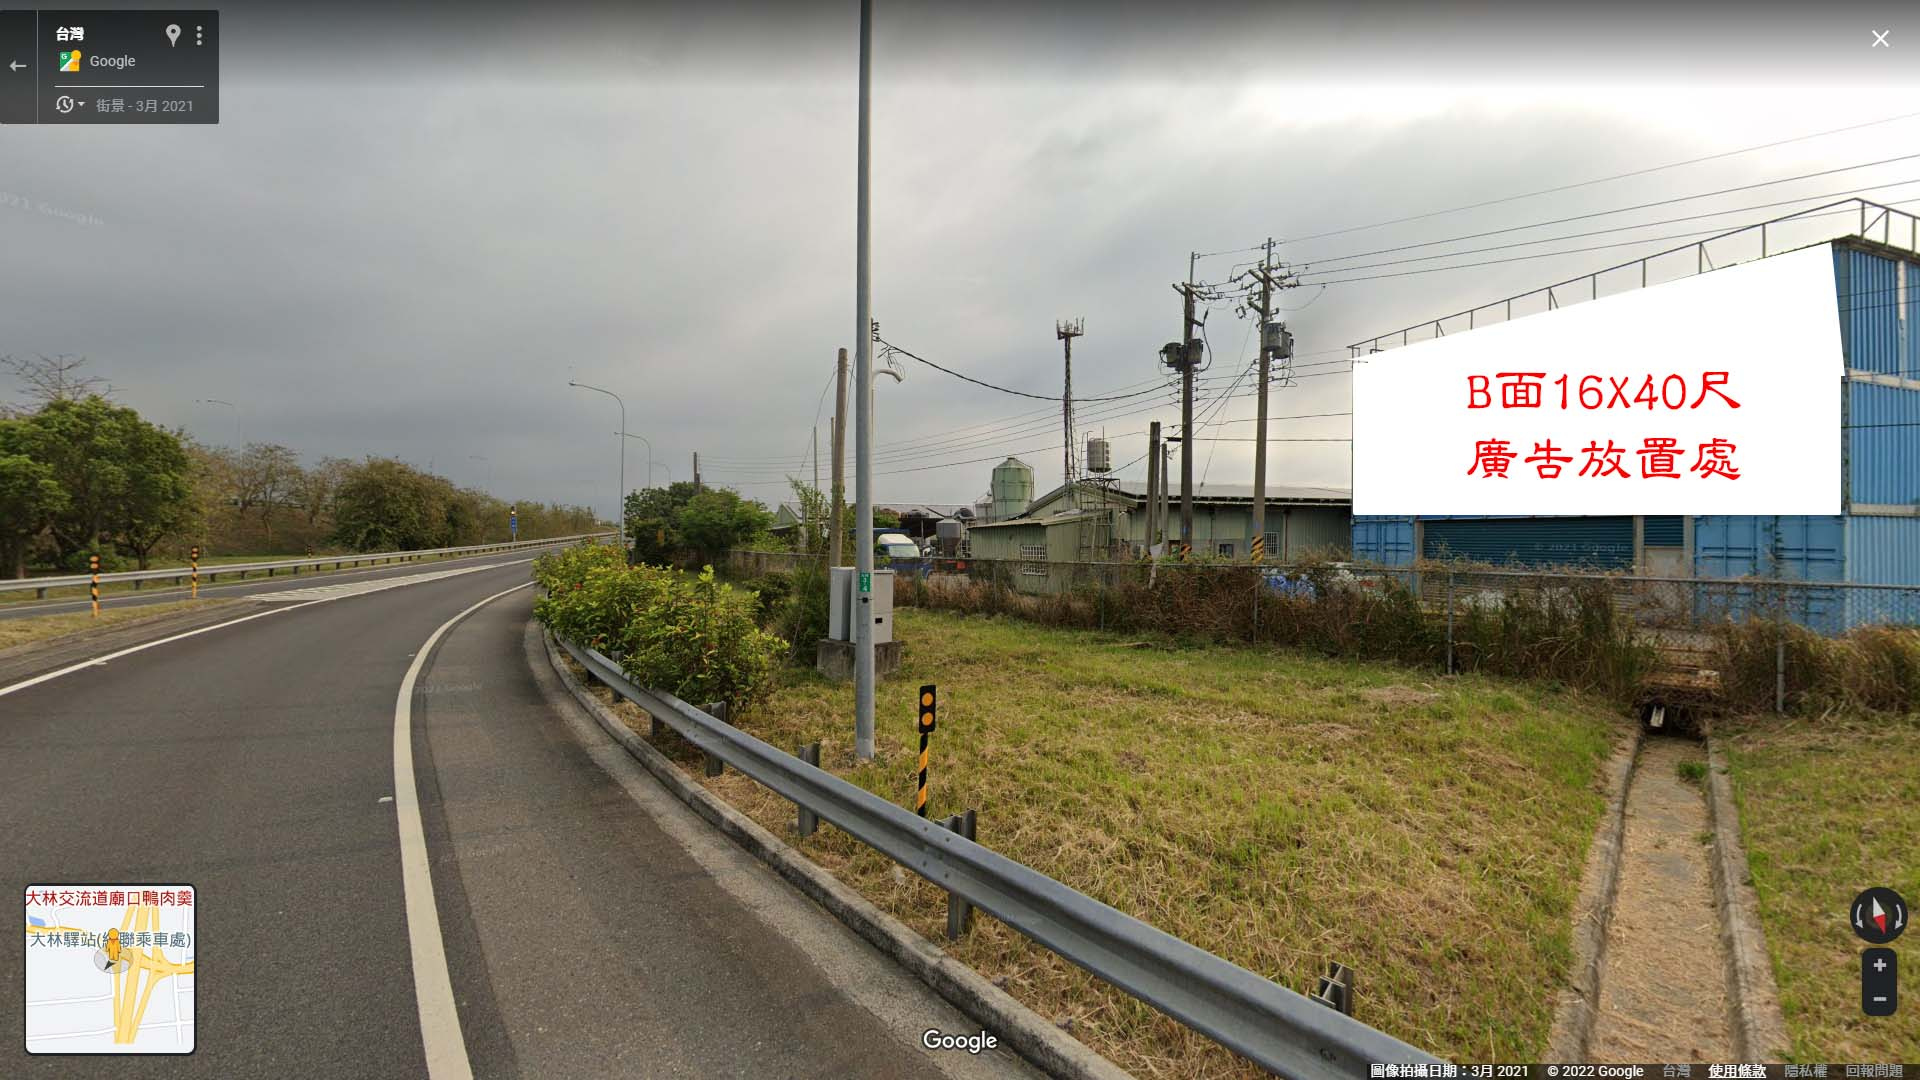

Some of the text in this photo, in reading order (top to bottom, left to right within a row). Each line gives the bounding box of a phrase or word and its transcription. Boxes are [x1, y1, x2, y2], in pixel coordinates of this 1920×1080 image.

[1466, 371, 1742, 410] B面16X40尺
[1466, 437, 1742, 480] 廣告放置處
